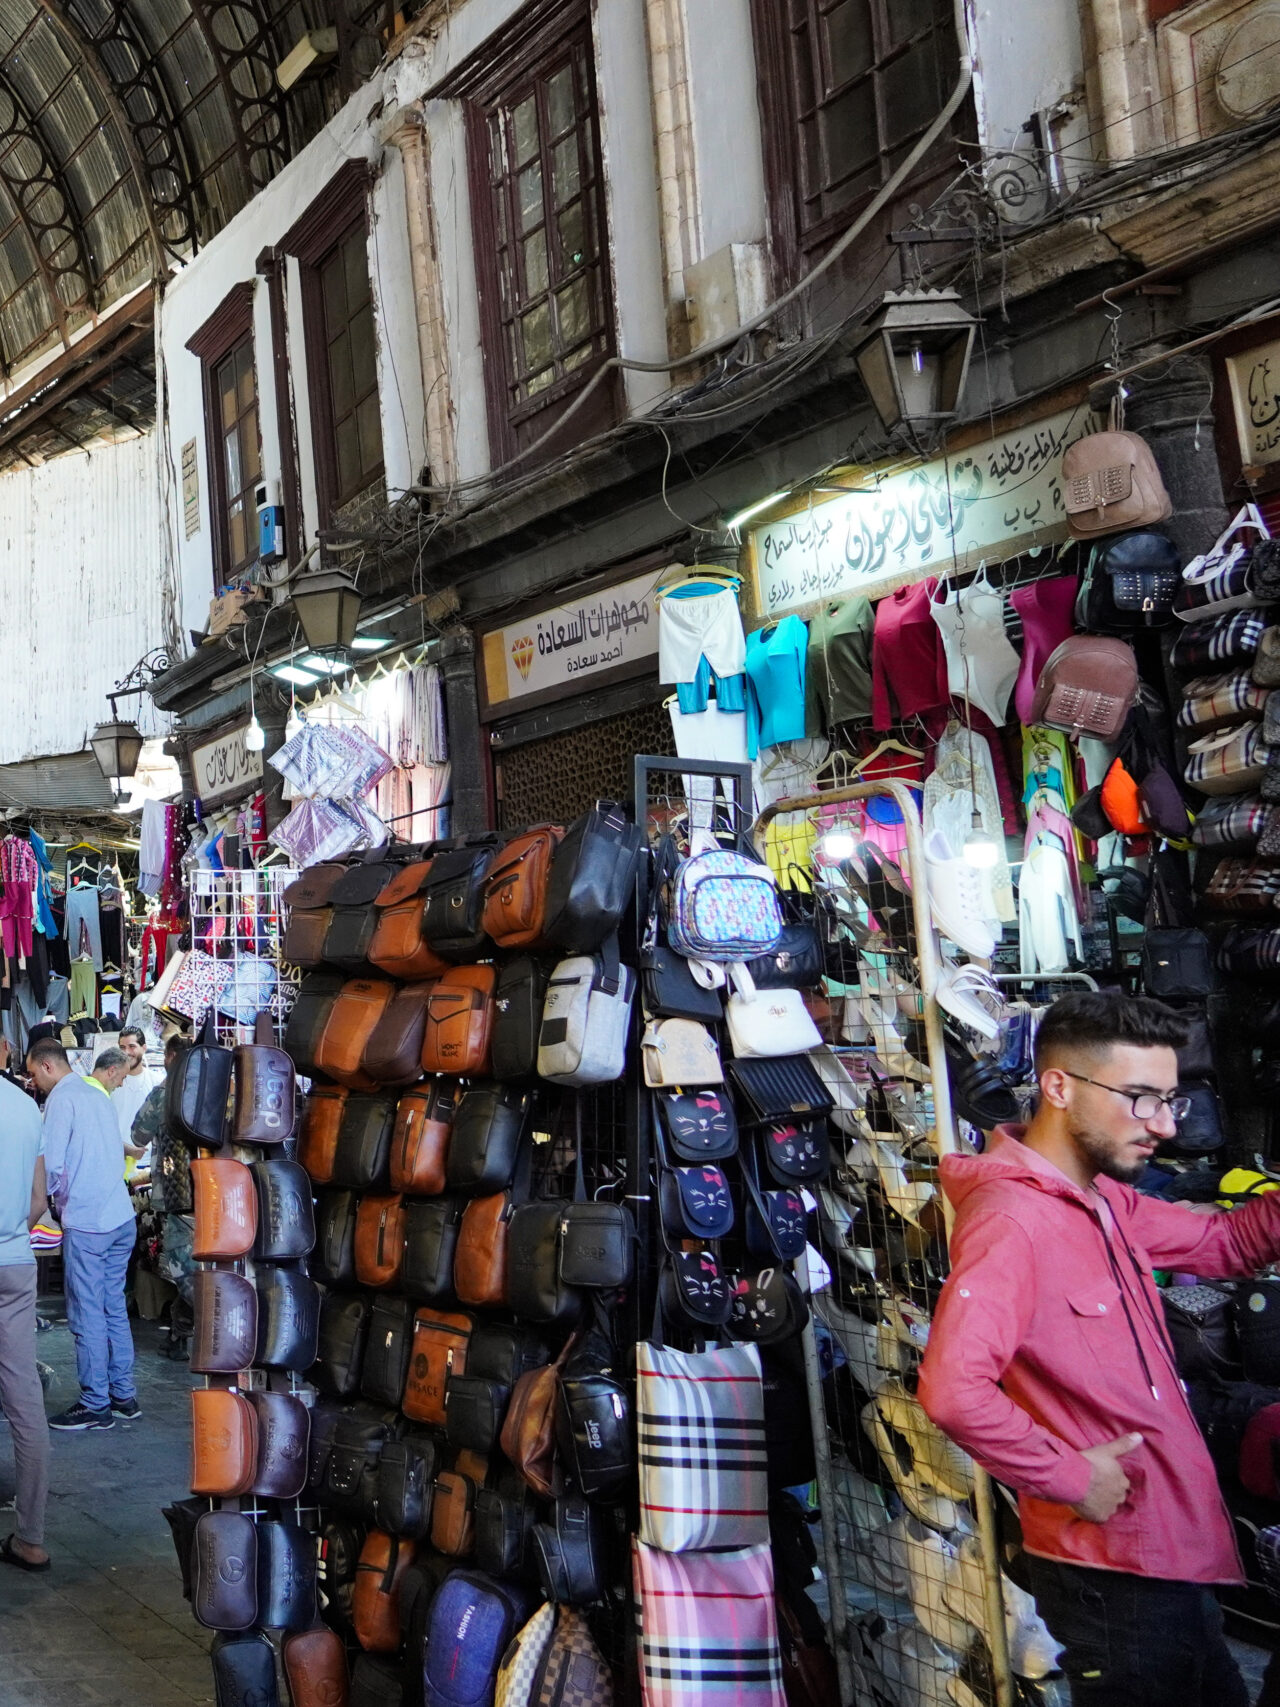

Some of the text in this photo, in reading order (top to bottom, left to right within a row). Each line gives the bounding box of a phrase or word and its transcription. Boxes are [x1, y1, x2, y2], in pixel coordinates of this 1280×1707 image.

[988, 441, 1025, 487] قطنية
[537, 599, 649, 655] مجوهرات السعادة
[567, 638, 623, 673] أحمد سعادة
[264, 1060, 289, 1128] Jeep
[588, 1420, 602, 1448] Jeep
[456, 1605, 476, 1640] FASHION
